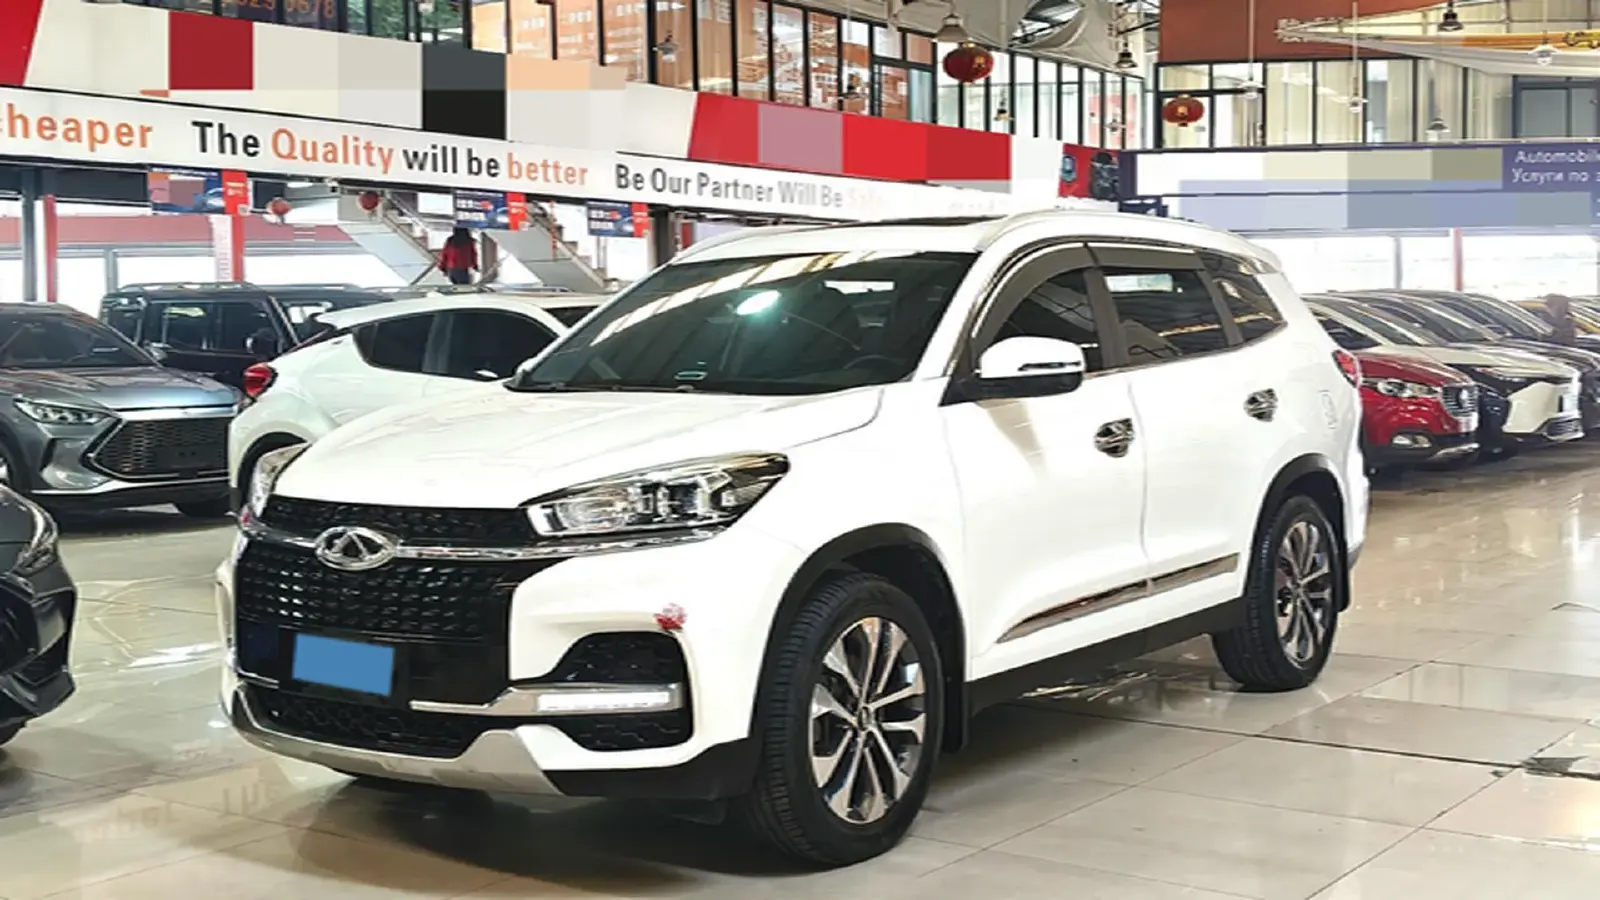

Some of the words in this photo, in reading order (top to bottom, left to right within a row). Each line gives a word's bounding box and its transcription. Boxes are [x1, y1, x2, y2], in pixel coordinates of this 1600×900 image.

[0, 102, 153, 152] heaper
[191, 120, 261, 157] The
[271, 127, 394, 174] Quality
[402, 144, 458, 174] will
[467, 148, 500, 177] be
[507, 152, 588, 185] better
[615, 163, 645, 191] Be
[651, 167, 692, 195] Our
[697, 172, 773, 202] Partner
[777, 180, 817, 206] Will
[821, 184, 843, 208] Be
